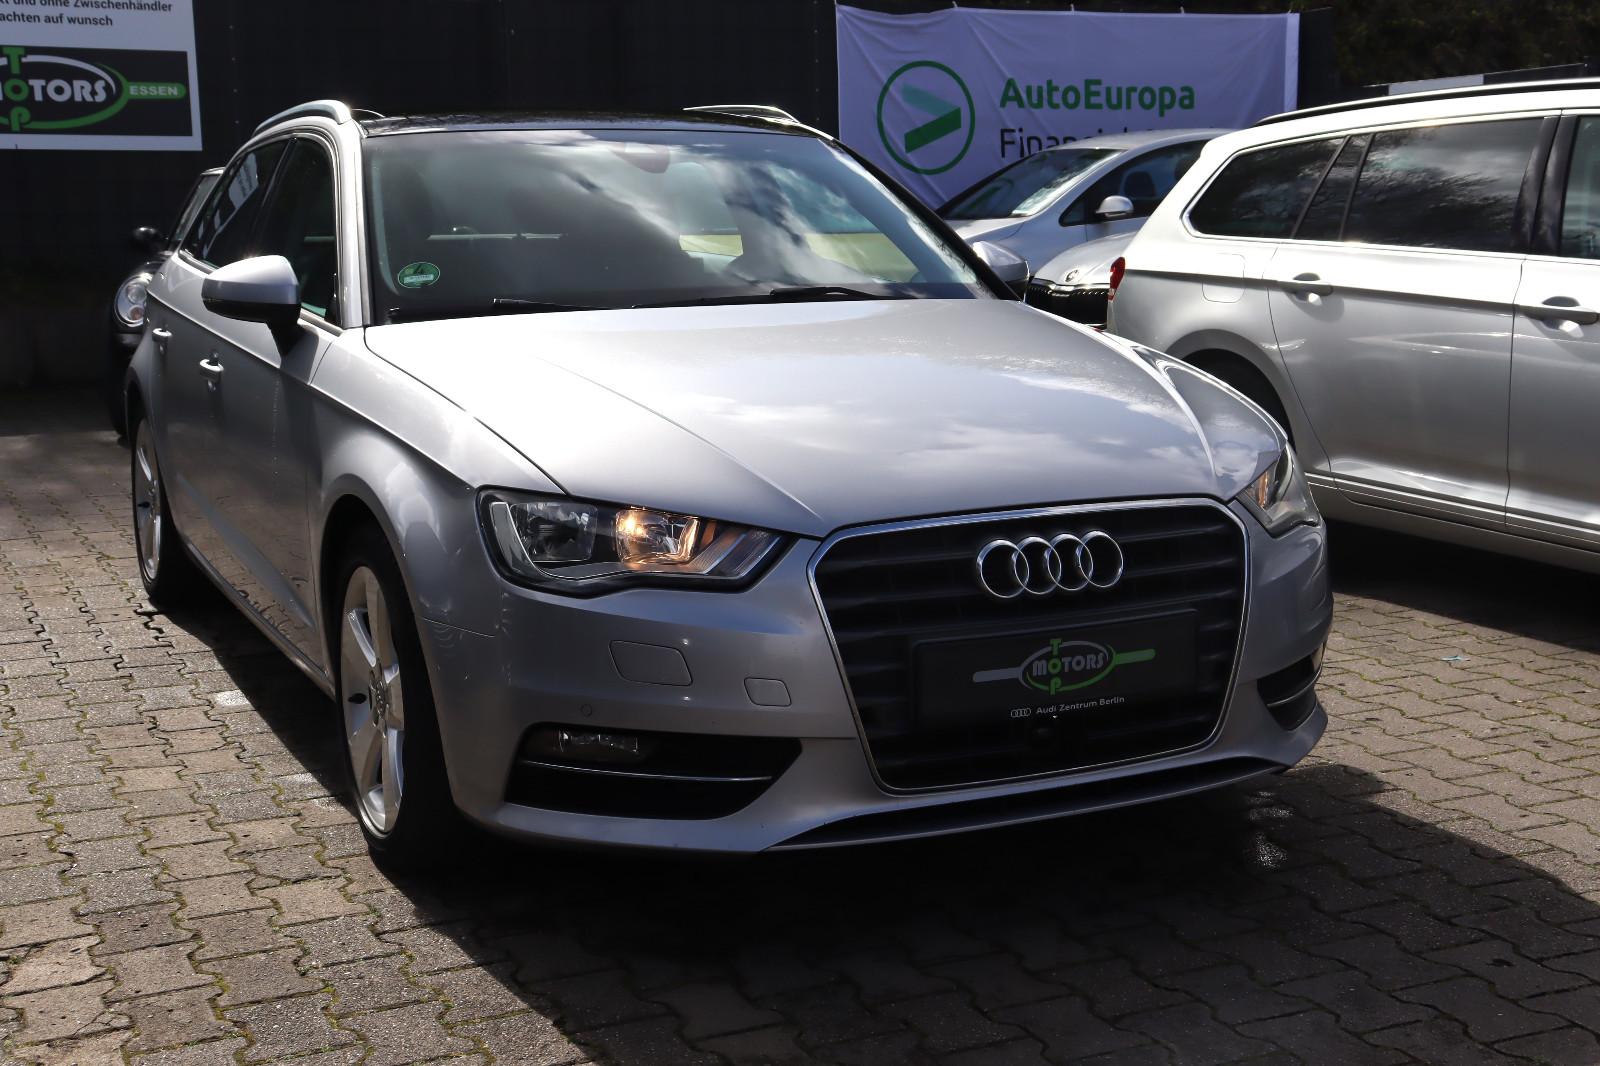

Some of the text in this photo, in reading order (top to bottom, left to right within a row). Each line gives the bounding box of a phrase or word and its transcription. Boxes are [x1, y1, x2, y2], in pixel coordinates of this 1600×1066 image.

[73, 0, 172, 12] Zwischenhändler
[44, 13, 64, 25] auf
[67, 15, 113, 26] wunsch
[0, 79, 107, 102] OTORS
[129, 85, 178, 96] ESSEN
[1000, 78, 1195, 117] AutoEuropa
[1032, 653, 1104, 676] MOTORS
[1036, 696, 1125, 714] Audi Zentrum Berlin
